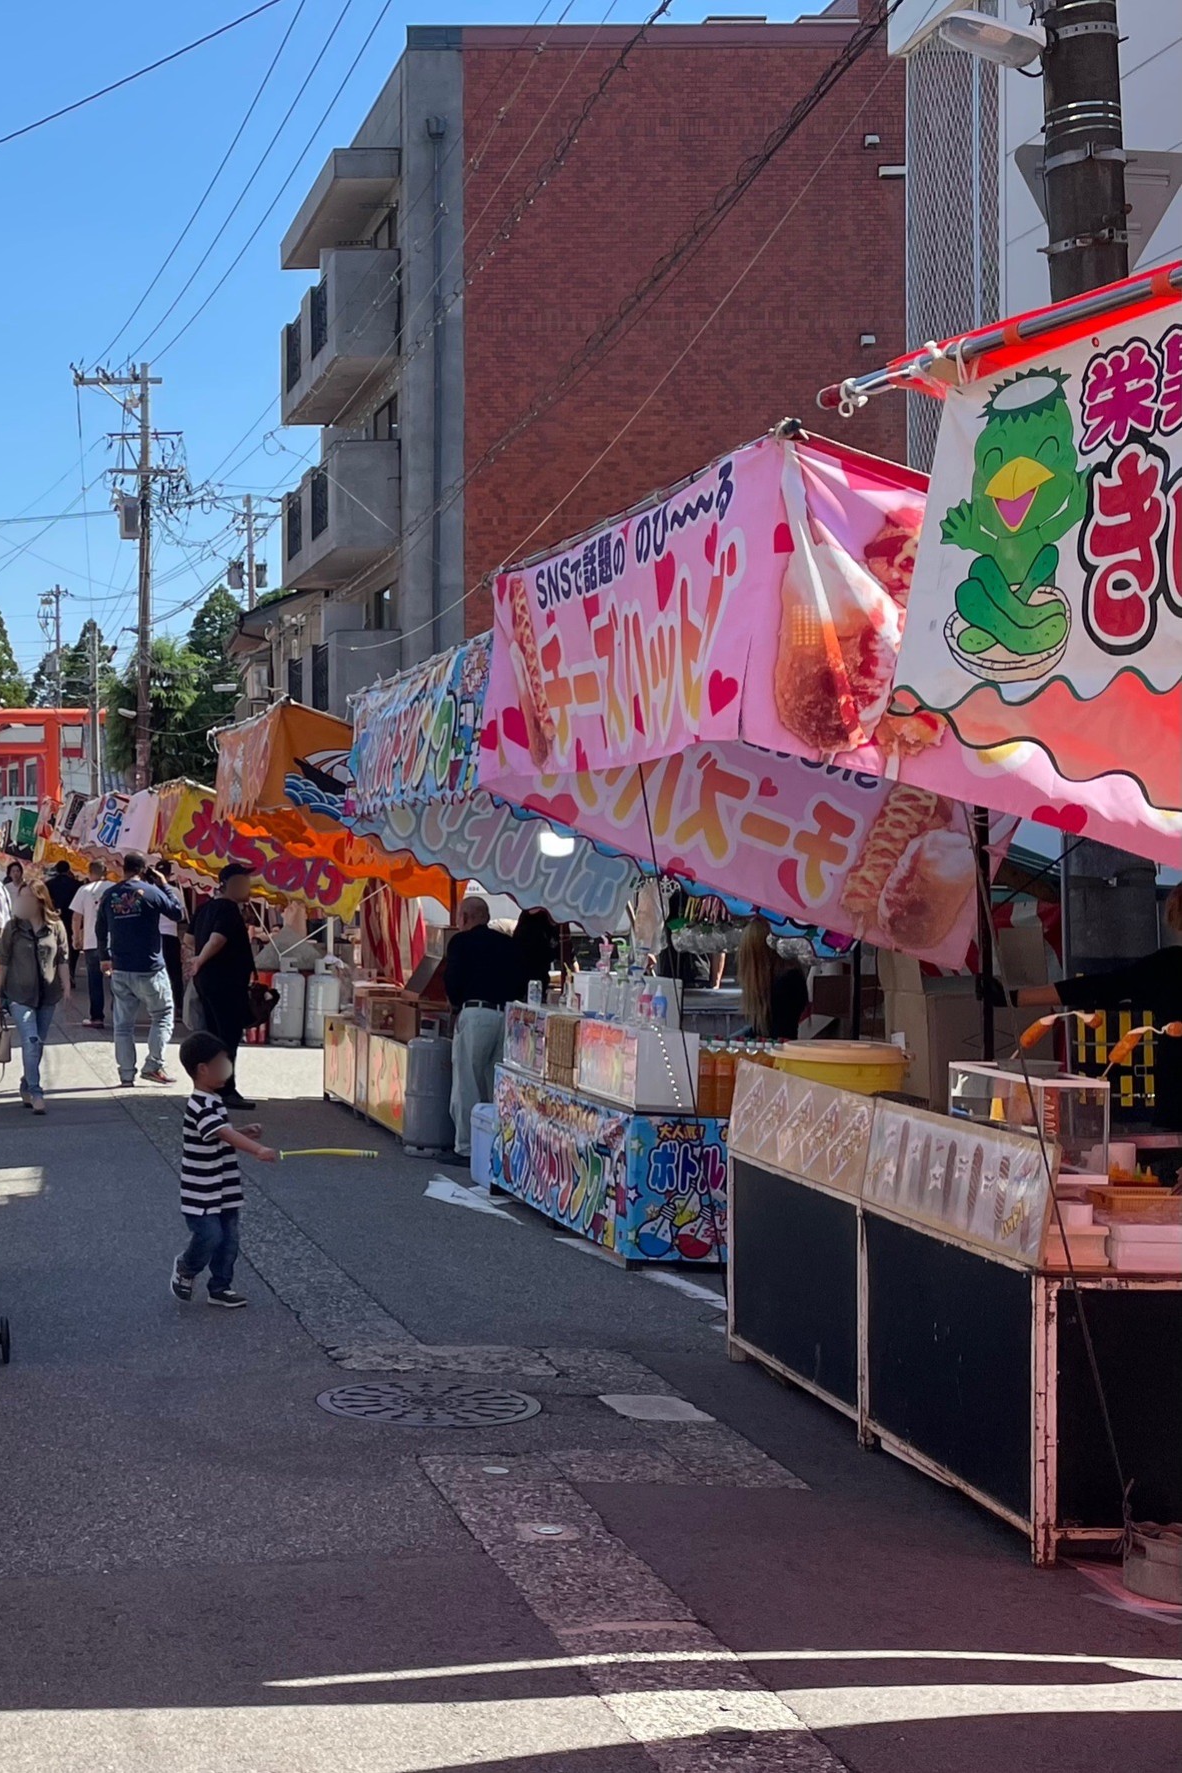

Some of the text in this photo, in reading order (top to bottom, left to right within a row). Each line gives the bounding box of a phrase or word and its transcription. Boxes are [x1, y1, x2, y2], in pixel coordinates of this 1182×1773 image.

[1080, 334, 1182, 455] 栄
[1077, 442, 1182, 656] き
[648, 1141, 727, 1195] ボトル
